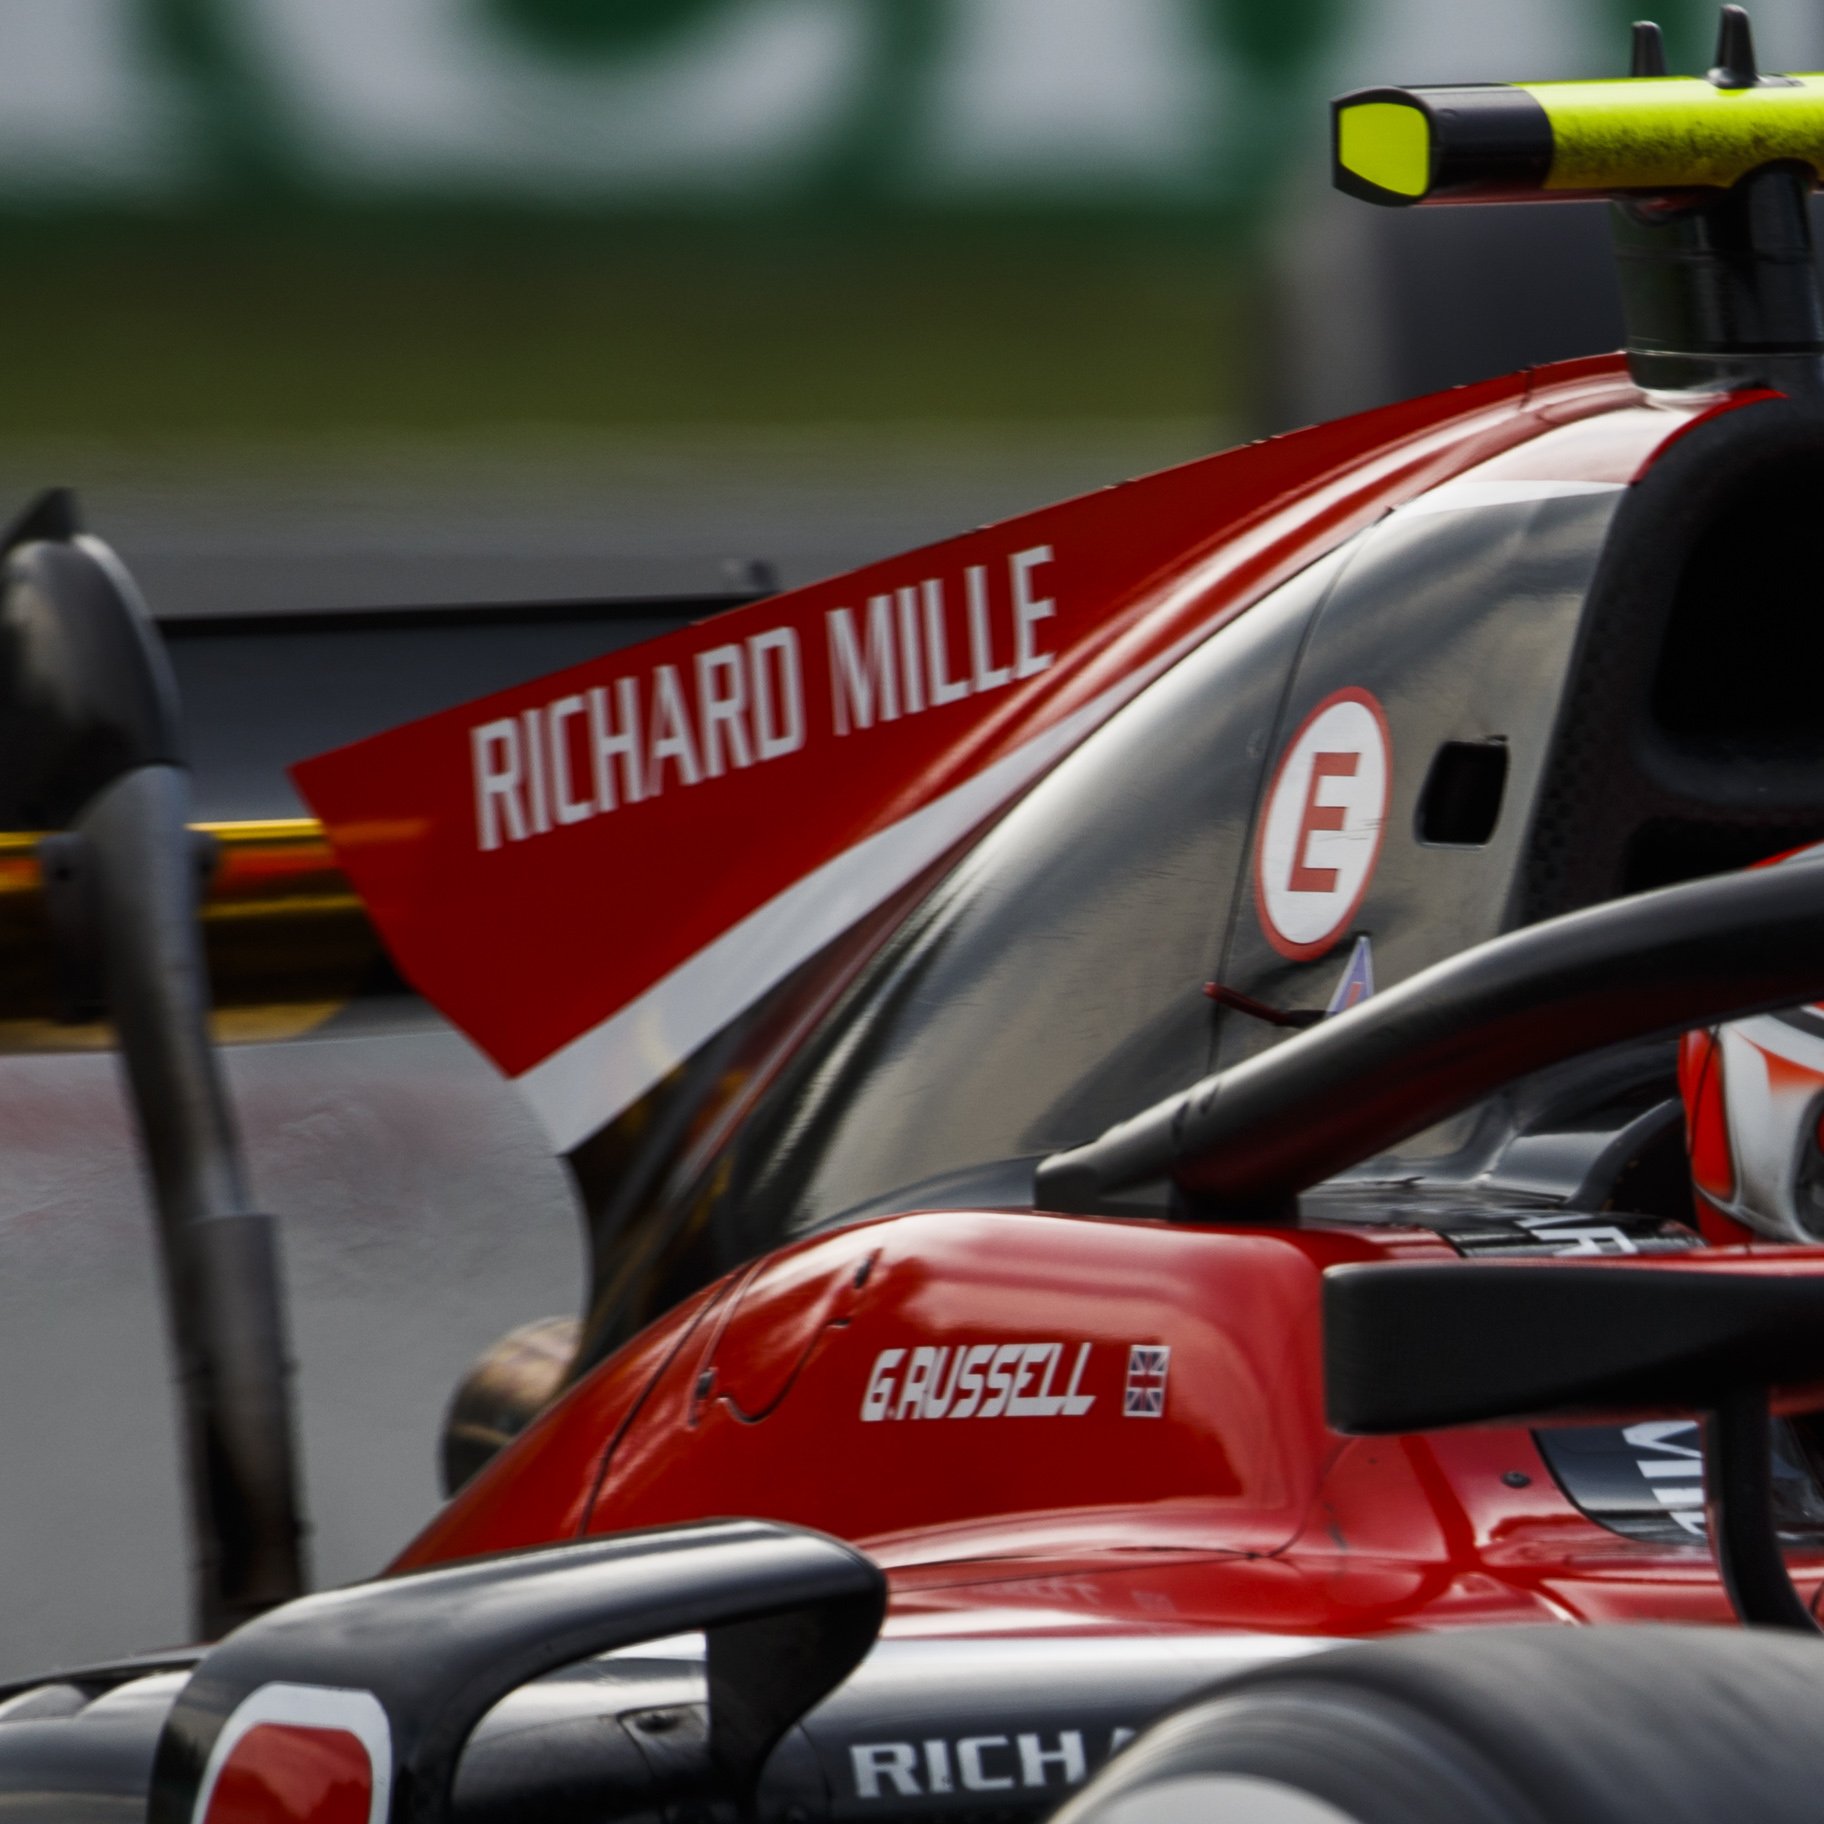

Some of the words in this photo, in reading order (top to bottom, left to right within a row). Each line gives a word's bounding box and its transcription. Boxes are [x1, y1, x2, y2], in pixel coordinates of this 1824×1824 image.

[470, 625, 806, 852] RICHARD
[825, 544, 1057, 737] MILLE
[1287, 751, 1361, 893] E
[859, 1341, 1097, 1422] G.RUSSELL
